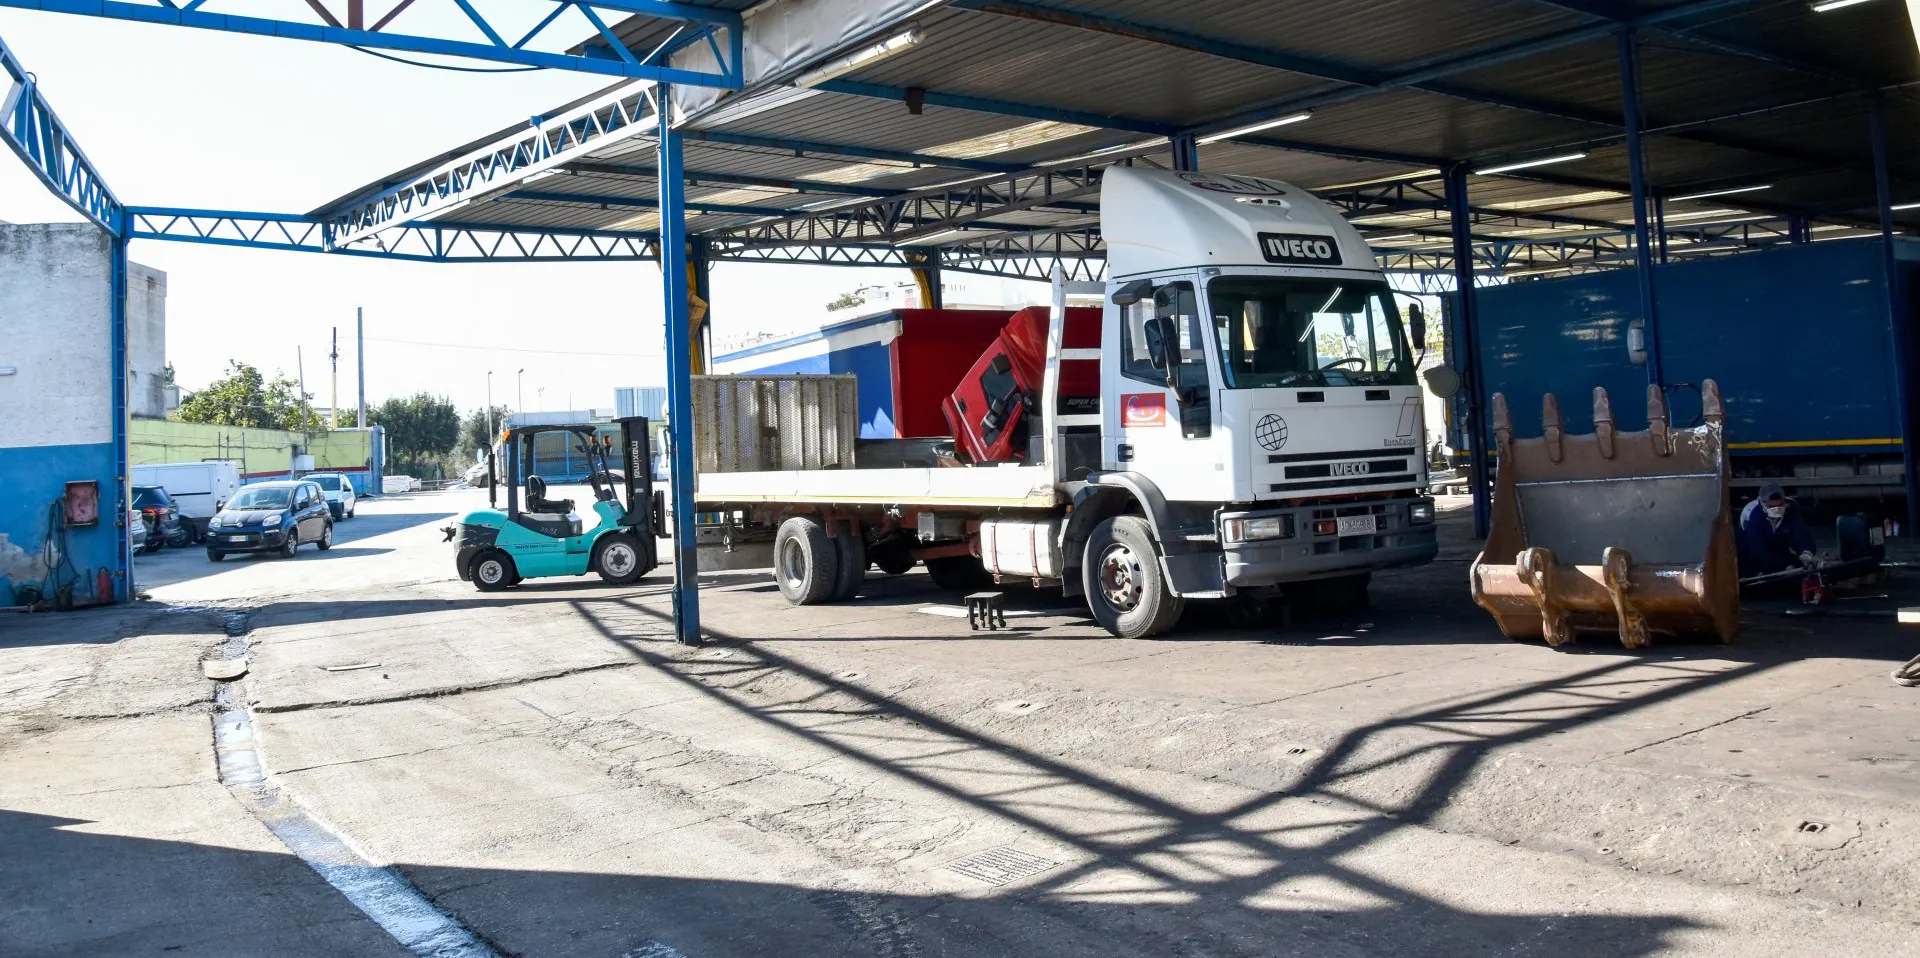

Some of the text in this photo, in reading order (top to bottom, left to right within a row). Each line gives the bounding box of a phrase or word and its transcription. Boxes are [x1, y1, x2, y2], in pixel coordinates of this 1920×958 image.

[1267, 238, 1332, 259] IVECO
[1066, 398, 1090, 406] SUPER
[632, 440, 643, 479] maximal
[1329, 461, 1370, 477] IVECO
